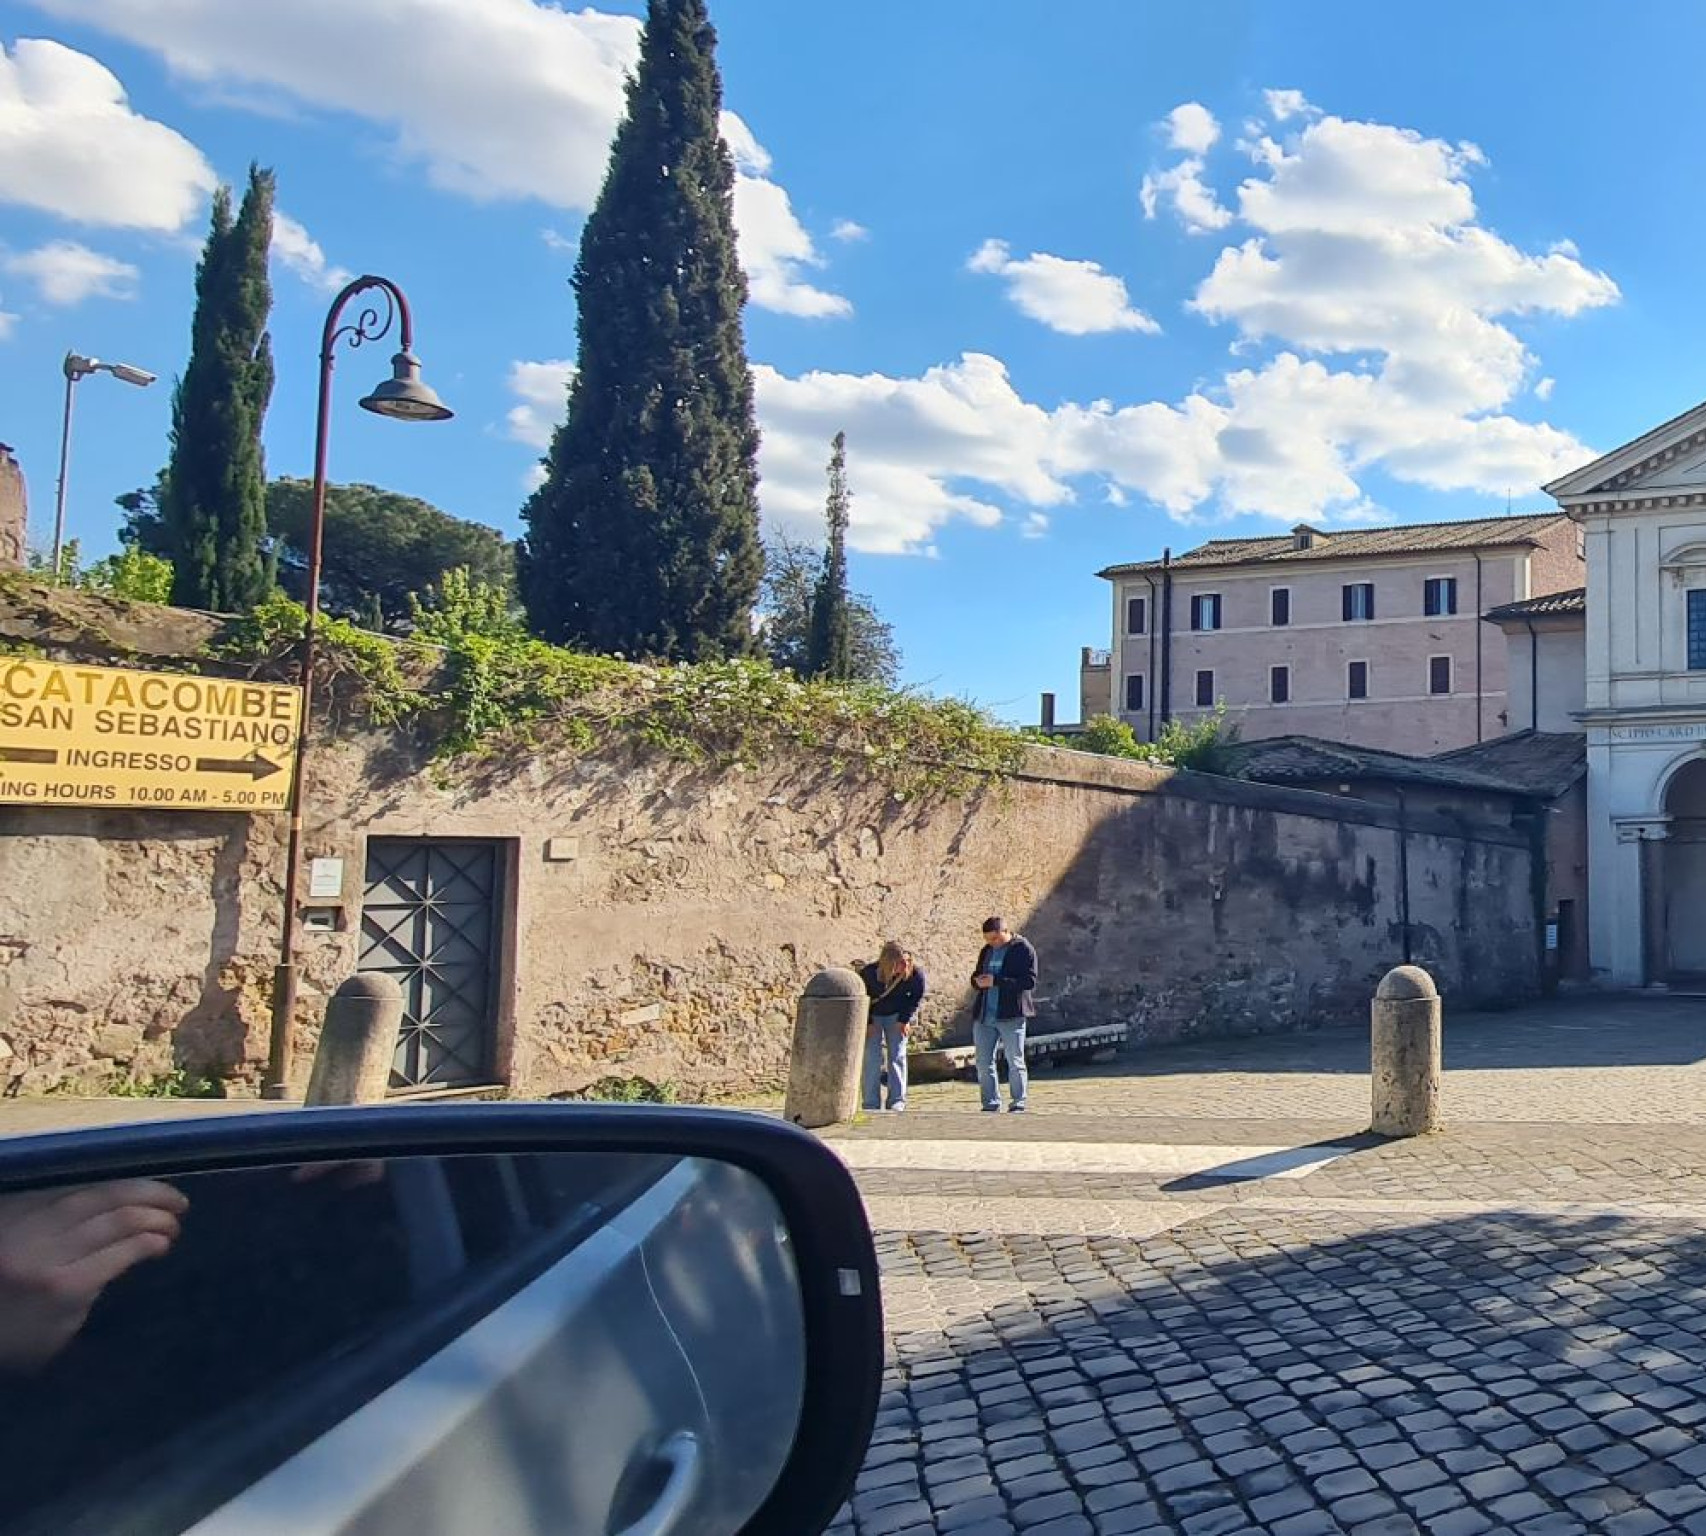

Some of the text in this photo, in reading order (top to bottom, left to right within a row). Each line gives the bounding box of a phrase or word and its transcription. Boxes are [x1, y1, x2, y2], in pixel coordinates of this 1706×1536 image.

[3, 664, 292, 721] CATACOMBE
[0, 702, 290, 745] SAN SEBASTIANO
[66, 748, 192, 773] INGRESSO
[44, 782, 117, 800] HOURS
[129, 786, 175, 802] 10.00
[180, 788, 208, 803] AM
[223, 790, 256, 805] 5.00
[261, 791, 286, 806] PM
